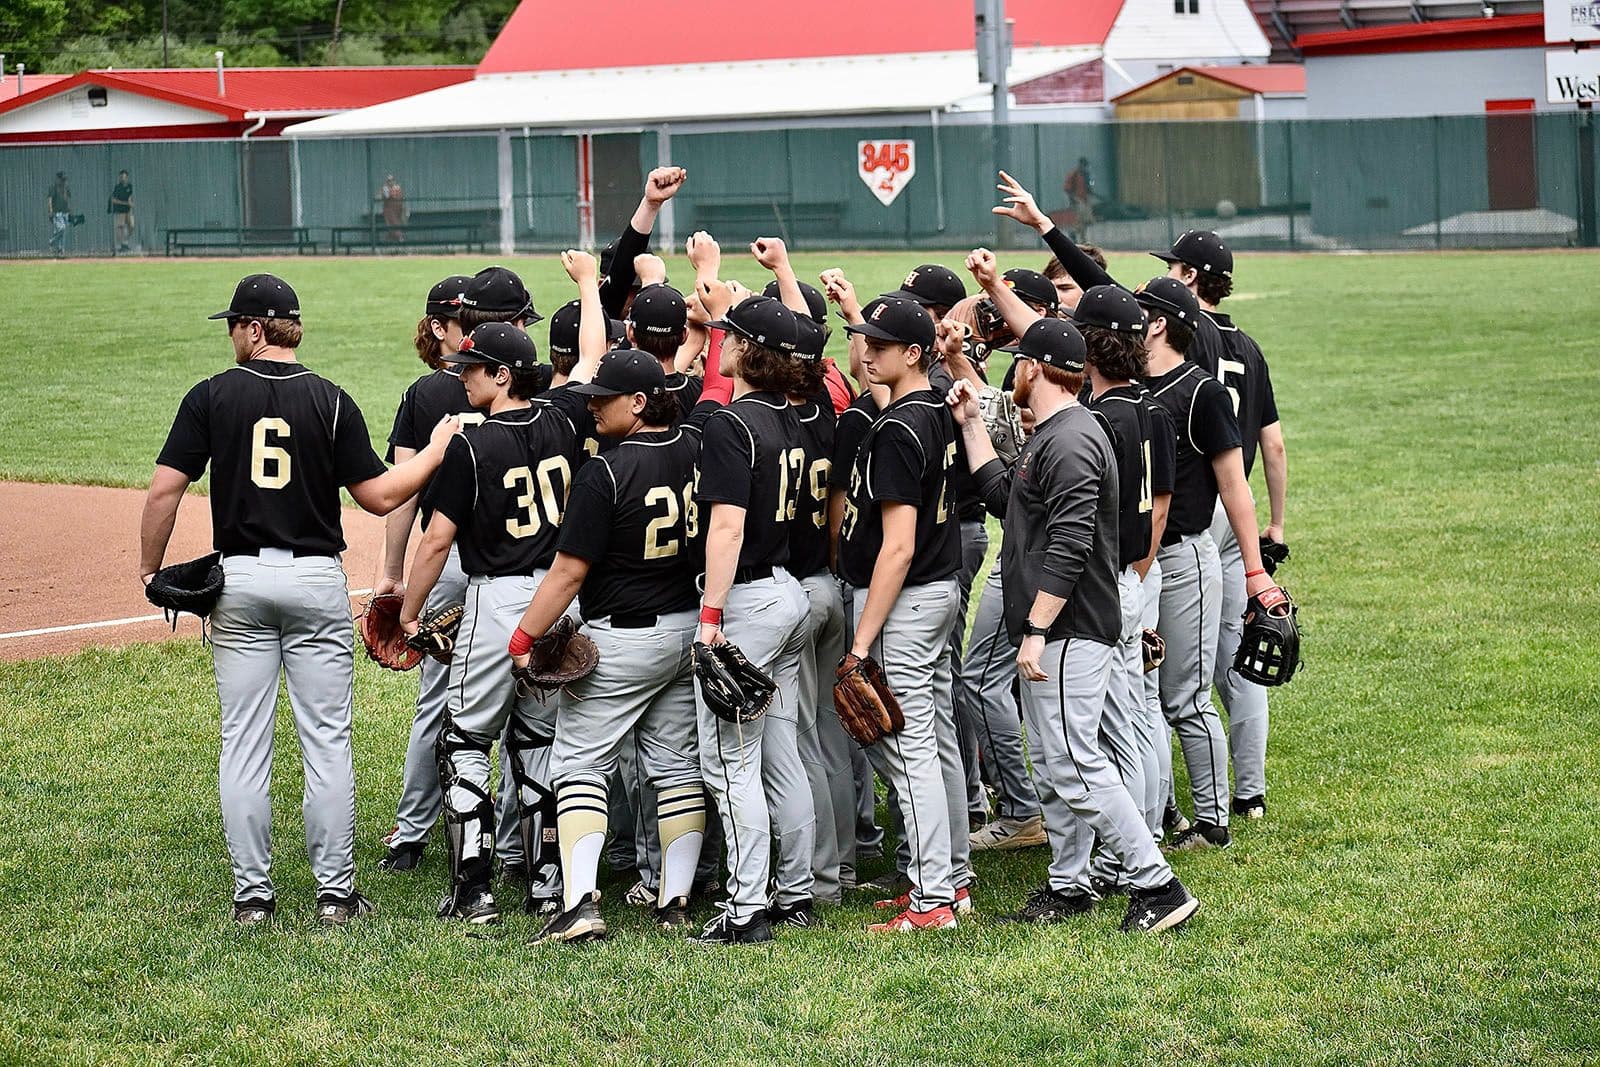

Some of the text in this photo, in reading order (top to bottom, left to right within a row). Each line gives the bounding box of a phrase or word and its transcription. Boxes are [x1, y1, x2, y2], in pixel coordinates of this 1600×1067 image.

[863, 143, 909, 172] 345
[1217, 357, 1245, 418] 5
[250, 416, 291, 489] 6
[775, 447, 805, 522] 13
[503, 454, 572, 539] 30
[990, 827, 1010, 841] N
